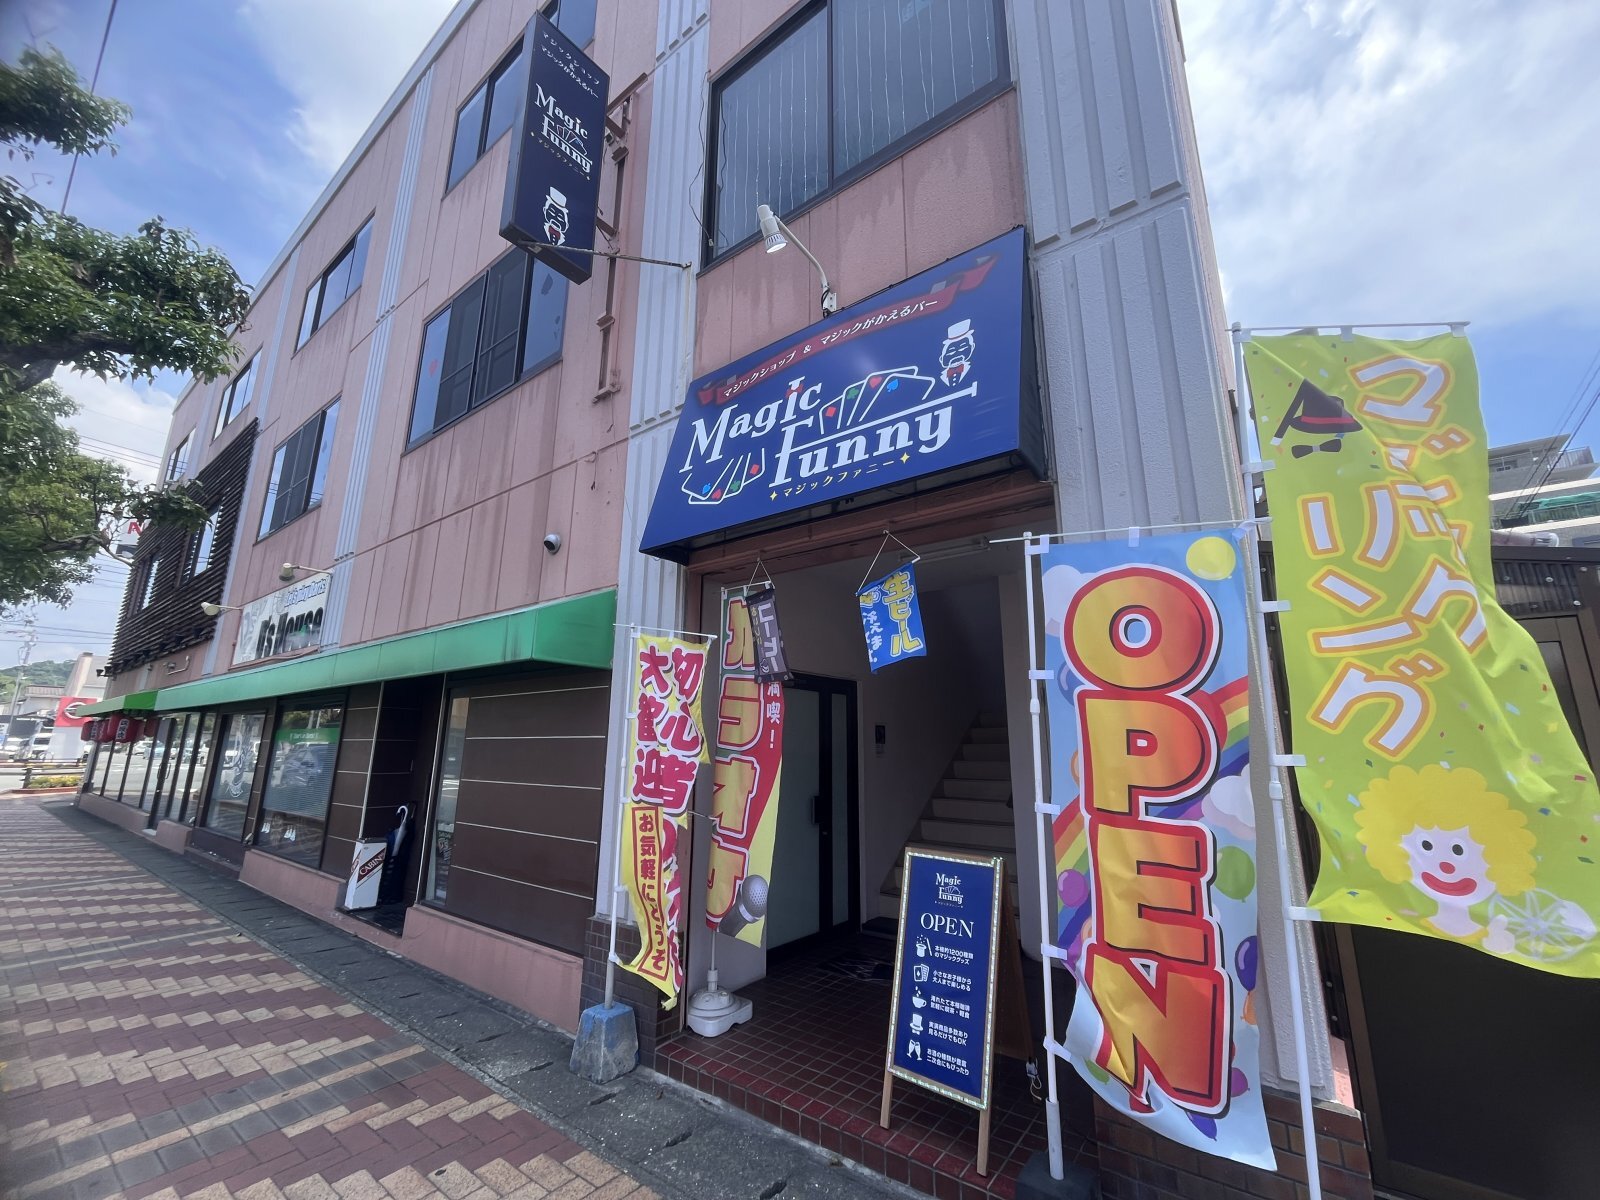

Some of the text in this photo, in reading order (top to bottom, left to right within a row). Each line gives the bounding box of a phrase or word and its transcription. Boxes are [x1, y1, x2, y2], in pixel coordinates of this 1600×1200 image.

[534, 82, 588, 139] Magic
[541, 114, 593, 173] Funny
[724, 301, 939, 397] マジックショップ & マジックがかえるバー
[679, 376, 823, 474] Magic
[769, 382, 977, 488] Funny
[784, 460, 895, 497] マジックファニー
[881, 572, 923, 657] 生ビール
[1302, 484, 1442, 756] リング
[1061, 564, 1231, 1117] OPEN
[935, 872, 962, 886] Magic
[938, 886, 963, 904] Funny
[920, 912, 975, 938] OPEN
